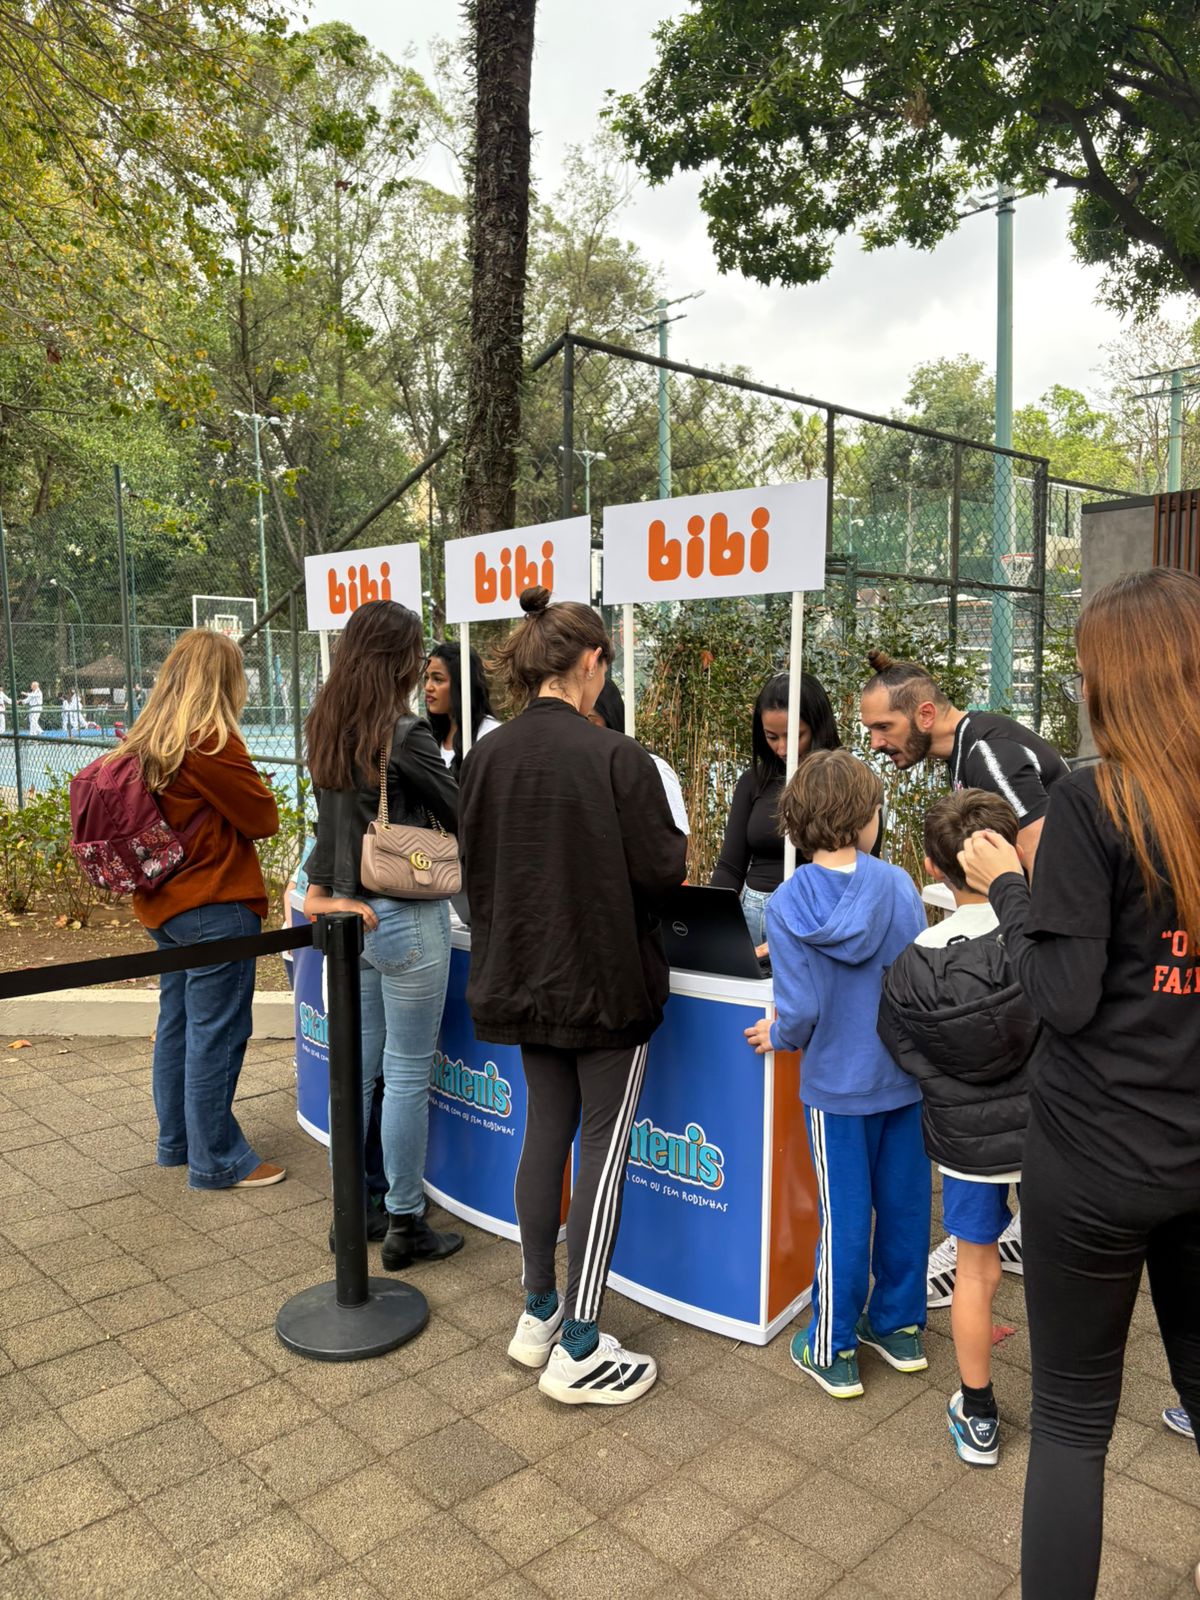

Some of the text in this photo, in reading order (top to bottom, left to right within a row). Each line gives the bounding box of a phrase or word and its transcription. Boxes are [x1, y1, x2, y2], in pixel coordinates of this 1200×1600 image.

[474, 540, 554, 605] bibi
[648, 506, 769, 581] bibi
[328, 562, 391, 615] bibi
[483, 1119, 515, 1136] RODINHAS
[630, 1120, 723, 1189] tenis
[631, 1174, 648, 1187] COM
[649, 1181, 661, 1192] OU
[662, 1185, 680, 1198] SEM
[682, 1191, 729, 1212] RODINHAS
